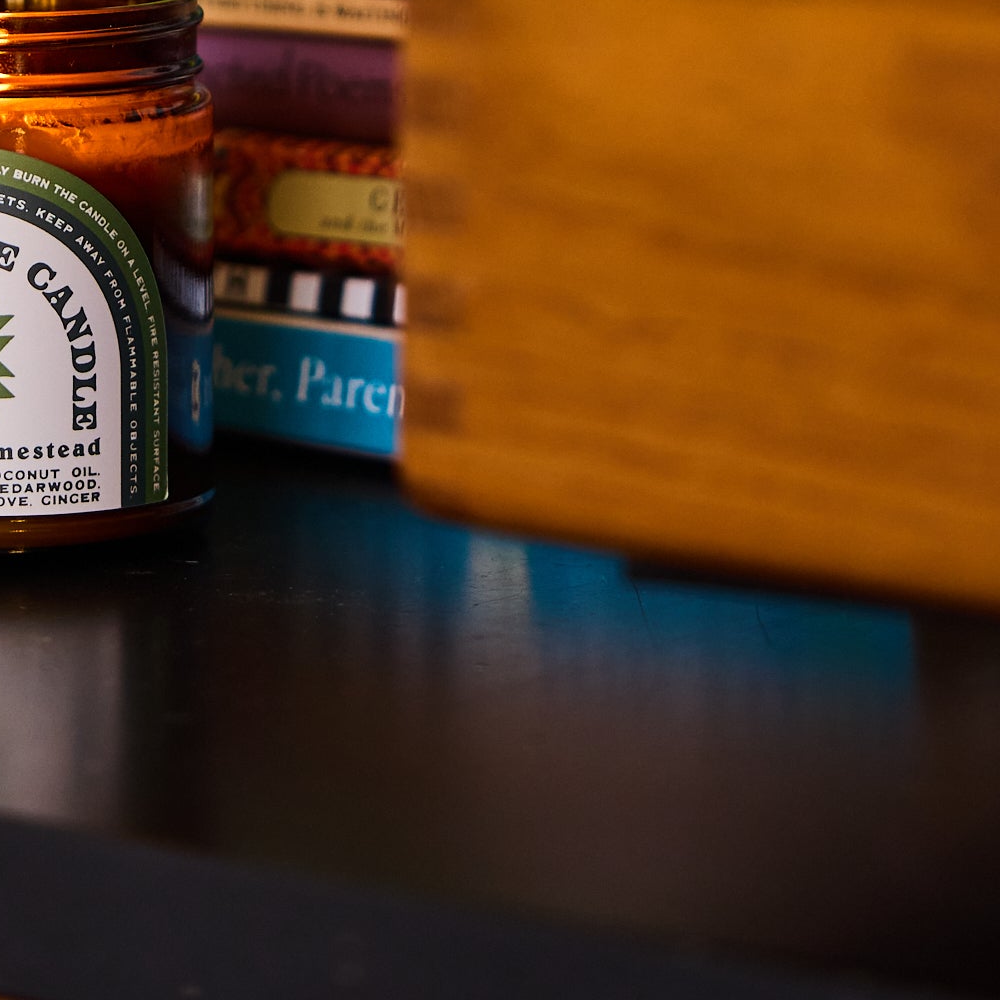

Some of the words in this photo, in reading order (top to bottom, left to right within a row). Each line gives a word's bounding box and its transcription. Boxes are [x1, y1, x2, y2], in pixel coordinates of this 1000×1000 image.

[12, 168, 51, 190] BURN
[53, 183, 79, 204] THE
[78, 200, 119, 240] CANDLE
[116, 239, 130, 257] ON
[127, 258, 136, 268] A
[35, 207, 74, 234] KEEP
[75, 235, 106, 266] AWAY
[104, 269, 127, 309] FROM
[122, 314, 137, 412] FLAMMABLE
[147, 315, 159, 347] FIRE
[27, 262, 97, 431] CANDLE
[151, 350, 160, 424] RESISTANT
[41, 492, 100, 506] GINGER
